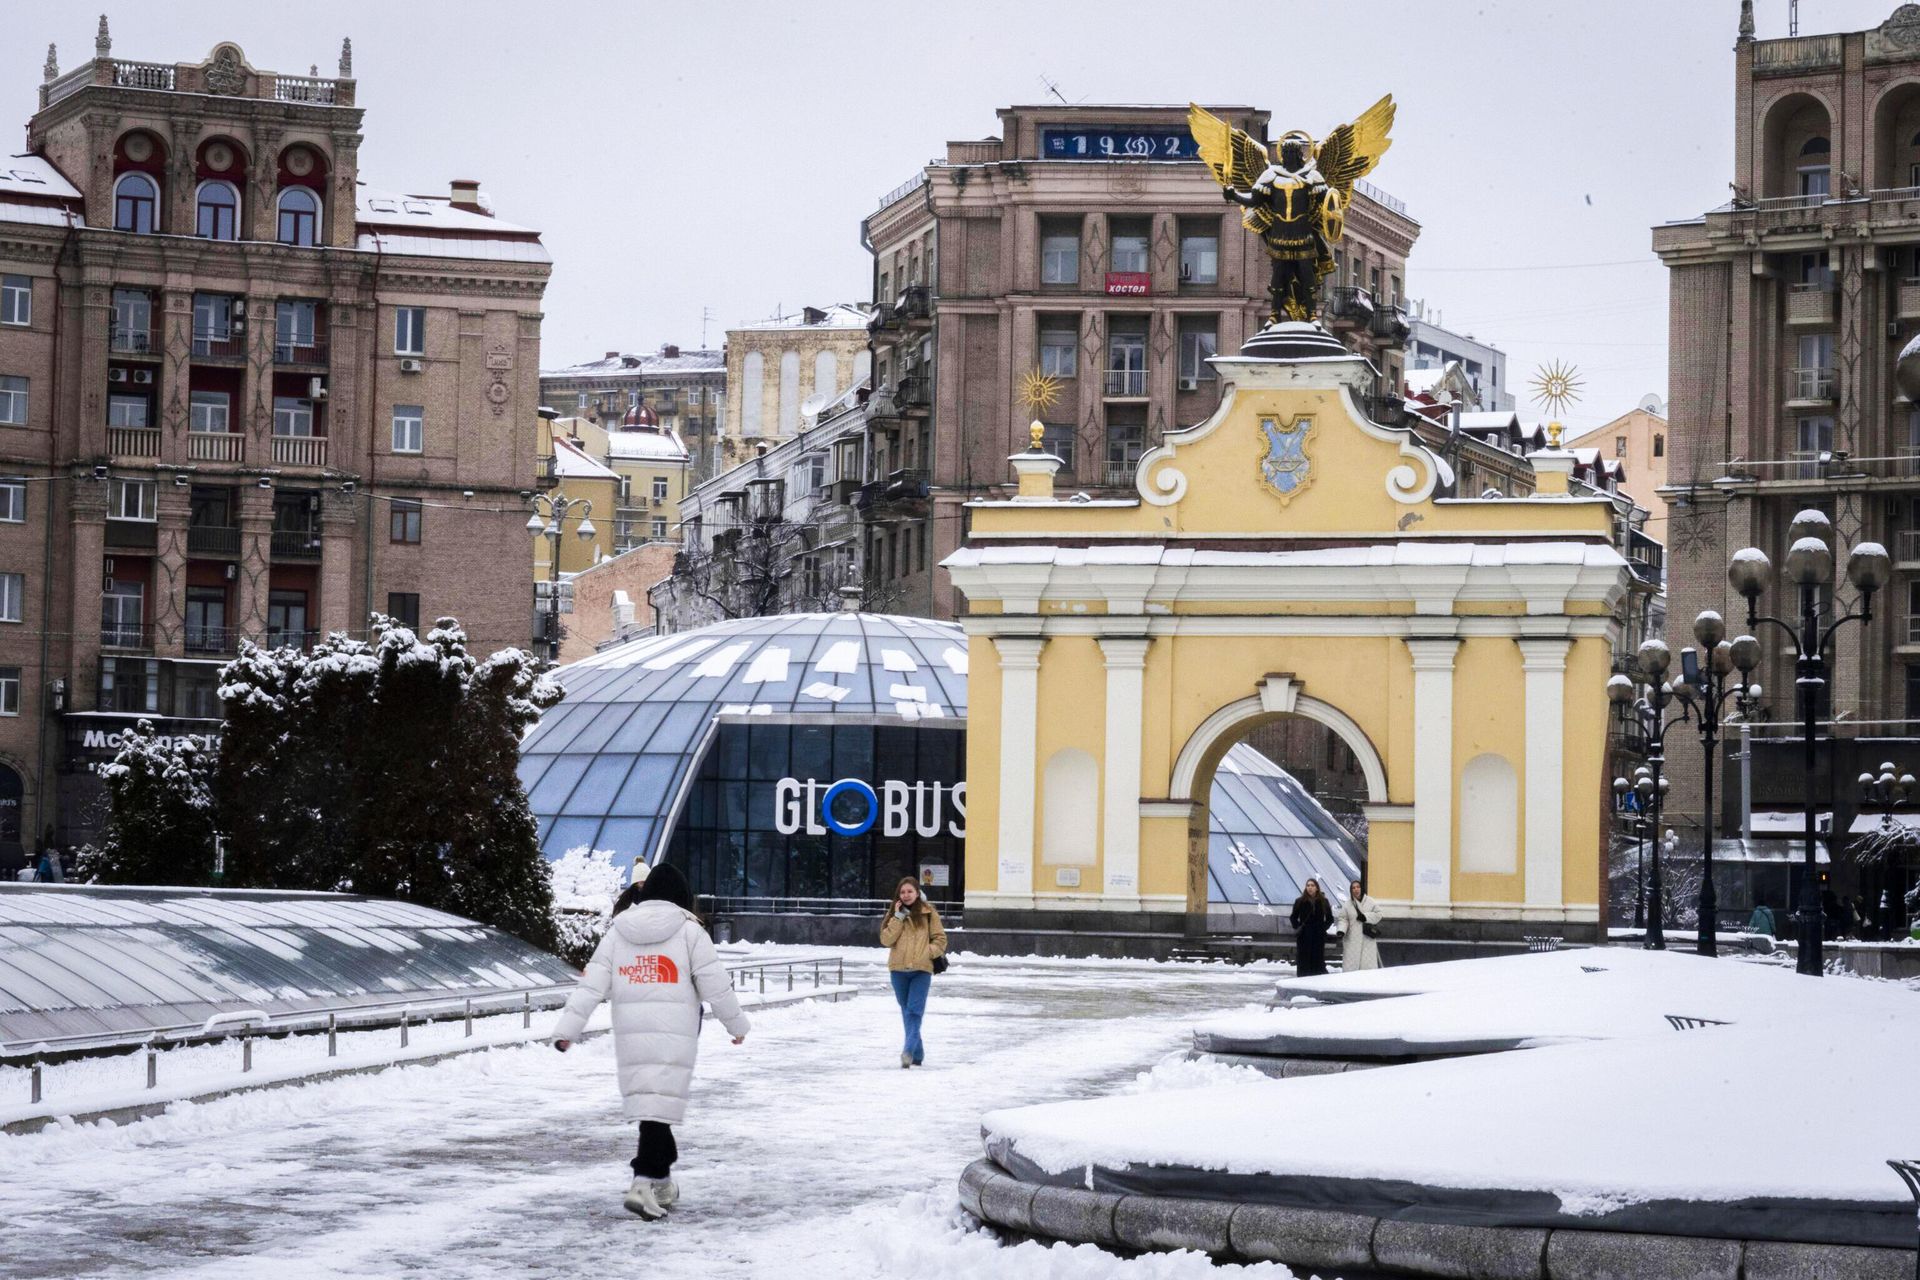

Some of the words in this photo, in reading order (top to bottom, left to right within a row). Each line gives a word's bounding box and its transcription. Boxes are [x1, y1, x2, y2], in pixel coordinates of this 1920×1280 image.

[1108, 285, 1146, 293] хостел
[776, 777, 966, 838] GLOBUS
[636, 955, 657, 965] THE
[619, 965, 657, 976] NORTH
[629, 974, 656, 984] FACE
